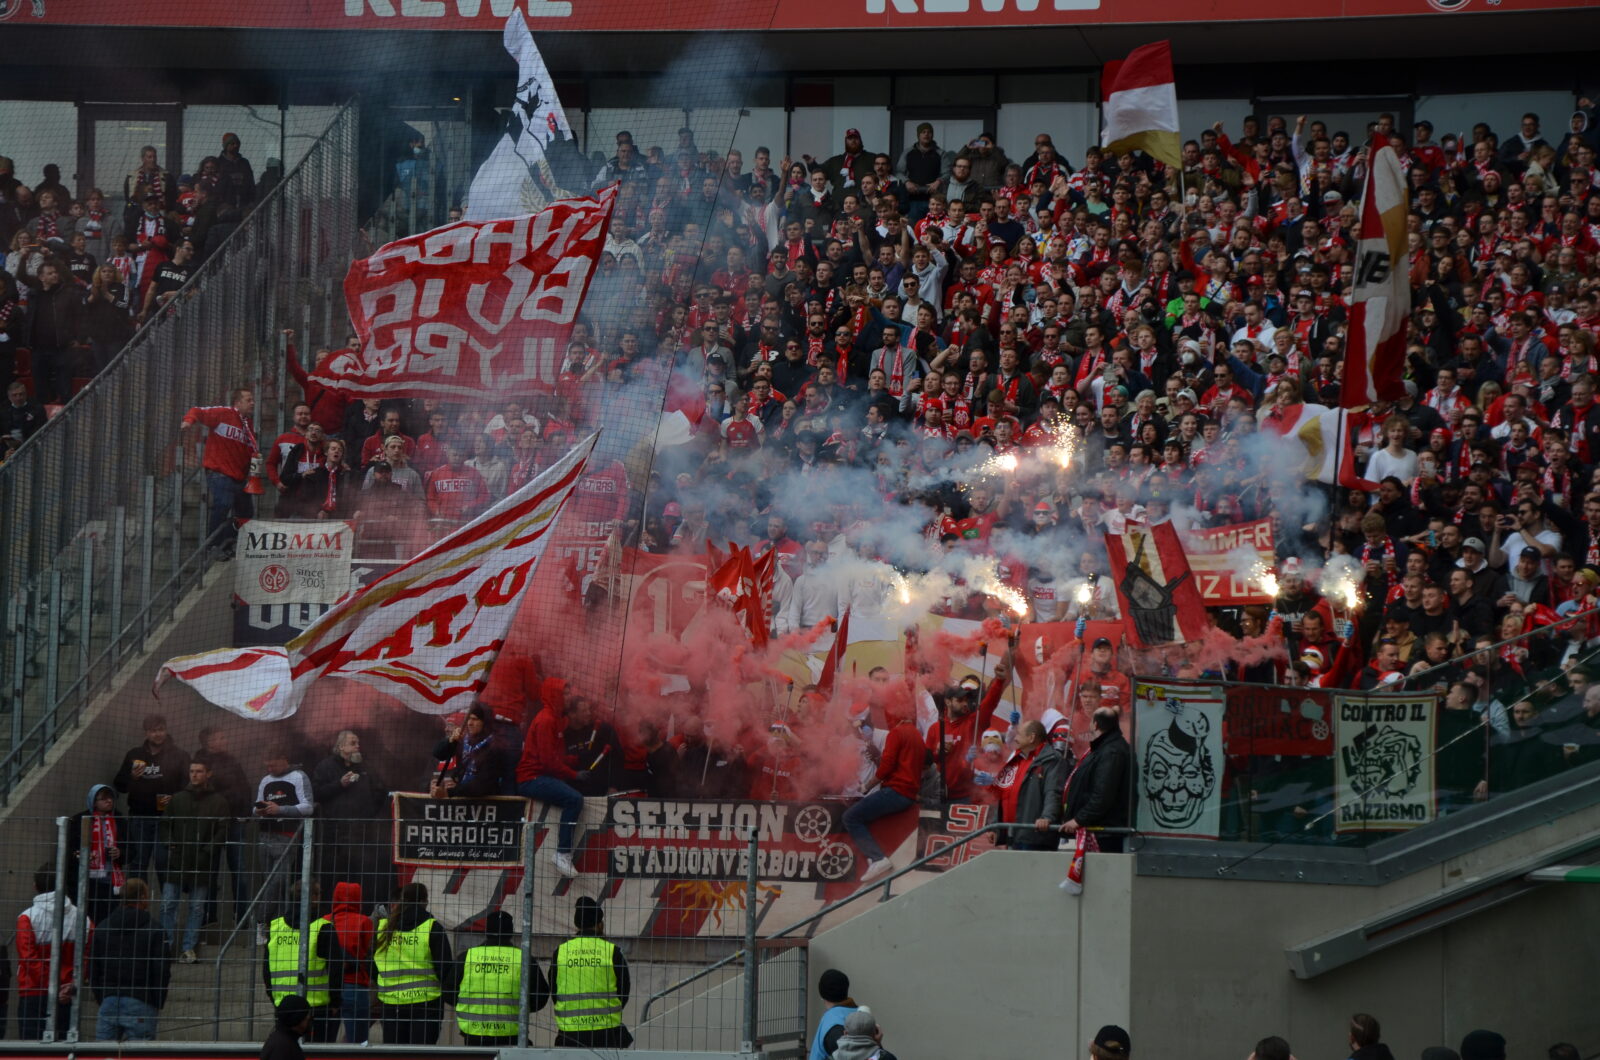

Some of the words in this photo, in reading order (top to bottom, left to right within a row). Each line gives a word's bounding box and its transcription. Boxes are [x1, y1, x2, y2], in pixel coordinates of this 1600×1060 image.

[160, 270, 187, 283] REWE
[245, 532, 344, 551] MBMM
[296, 567, 324, 578] since
[1341, 704, 1409, 722] CONTRO
[1410, 703, 1427, 722] IL
[425, 804, 497, 822] CURVA
[612, 800, 788, 842] SEKTION
[1341, 802, 1426, 822] RAZZISMO
[614, 845, 817, 878] STADIONVERBOT
[475, 963, 510, 974] ORDNER
[567, 957, 602, 969] ORDNER
